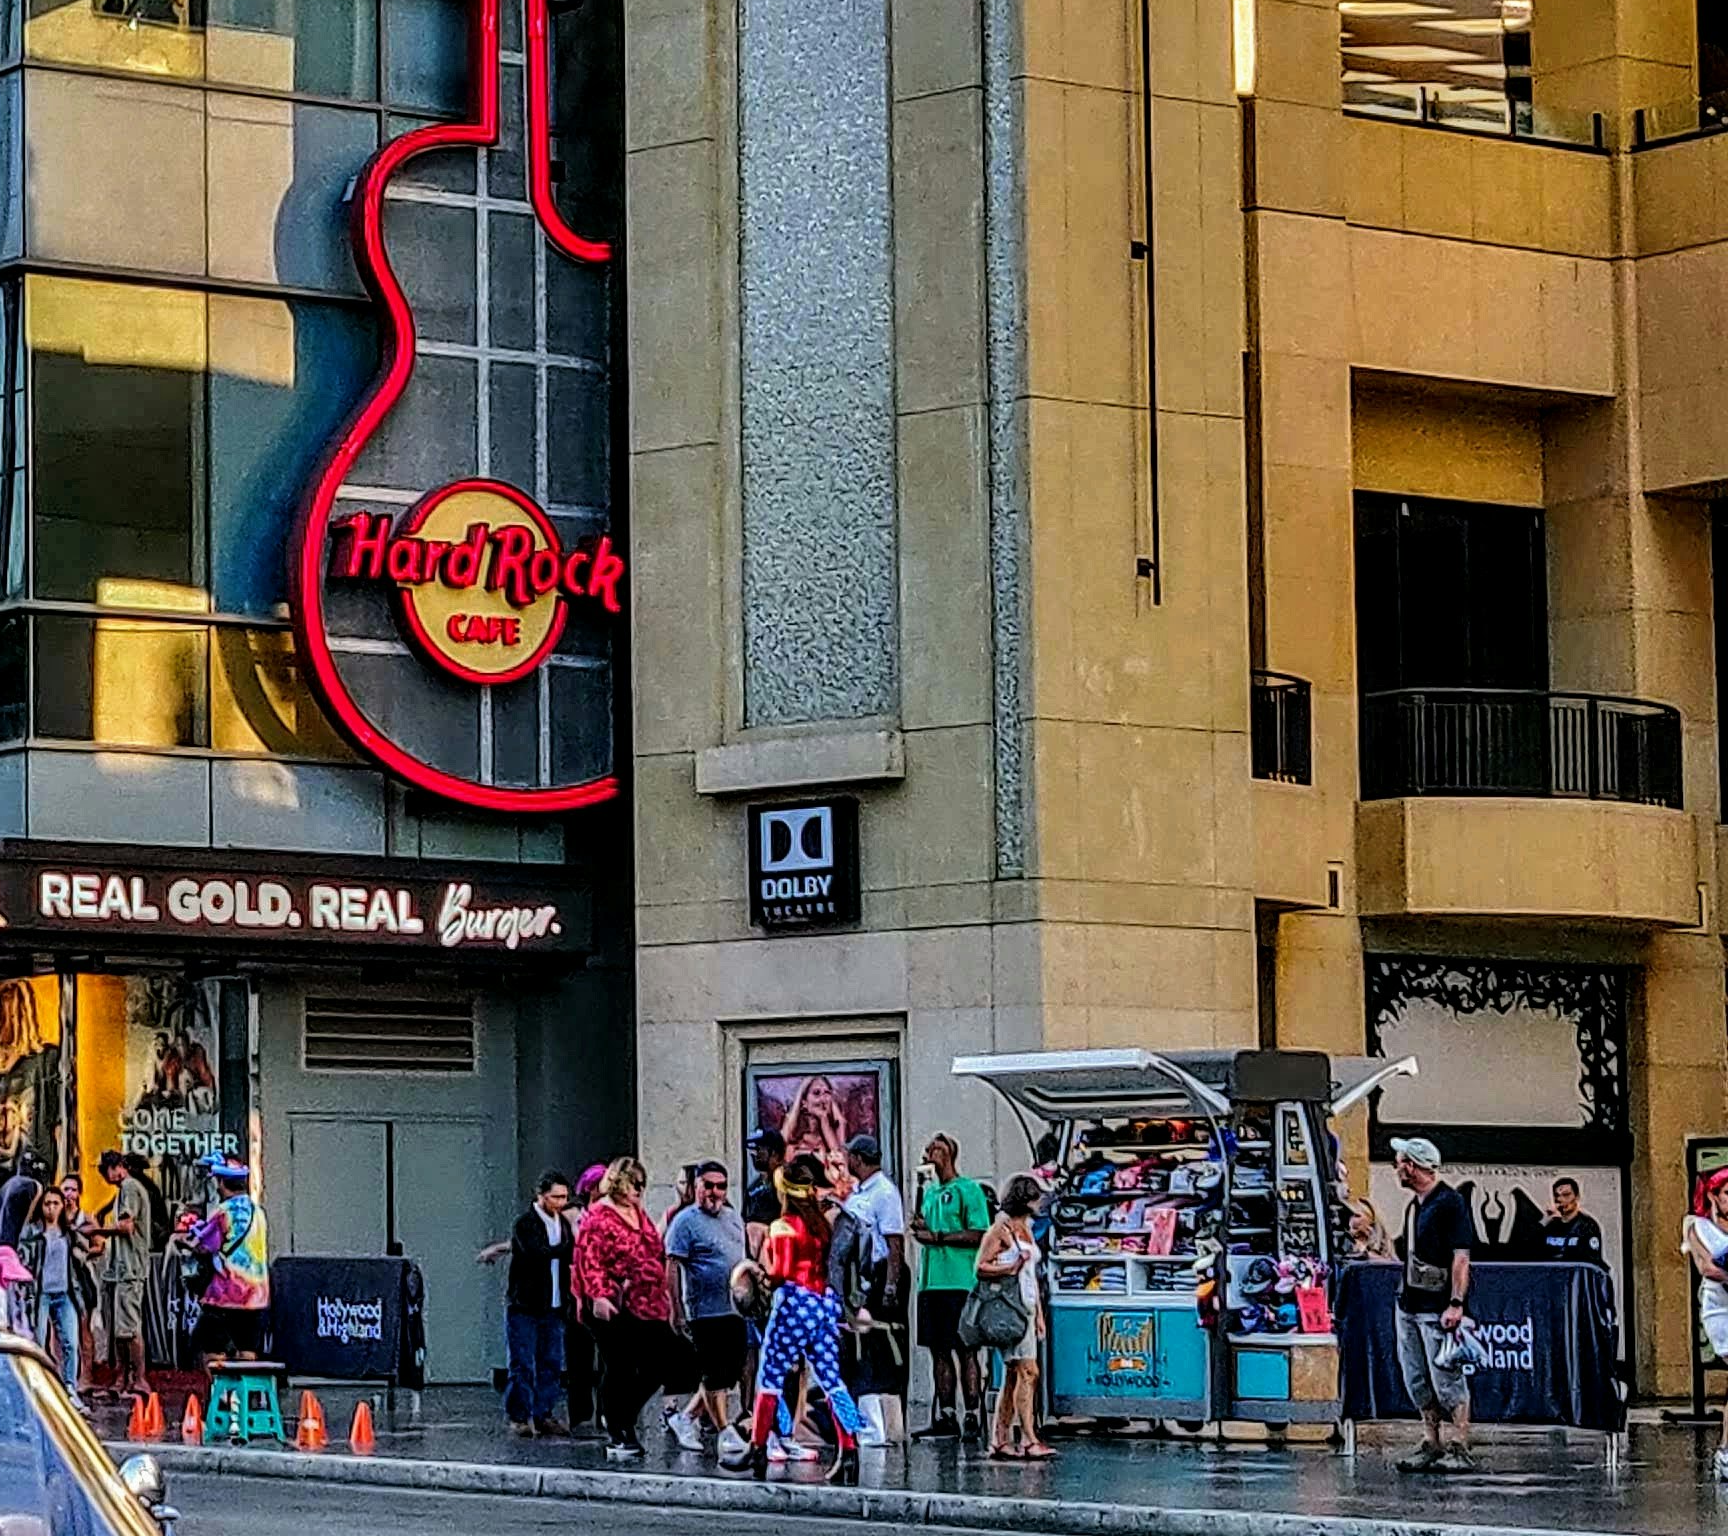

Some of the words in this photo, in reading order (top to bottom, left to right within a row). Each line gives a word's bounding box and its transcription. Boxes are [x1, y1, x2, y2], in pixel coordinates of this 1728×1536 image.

[344, 510, 490, 590] Hard
[488, 524, 625, 614] Rock
[446, 613, 522, 646] CAFE
[760, 874, 833, 900] DOLBY
[40, 871, 160, 921] REAL
[168, 878, 302, 928] GOLD.
[309, 884, 423, 935] REAL
[438, 882, 562, 950] Burger.
[118, 1106, 188, 1131] COME
[118, 1131, 239, 1155] TOGETHER
[317, 1297, 383, 1319] Hollywood
